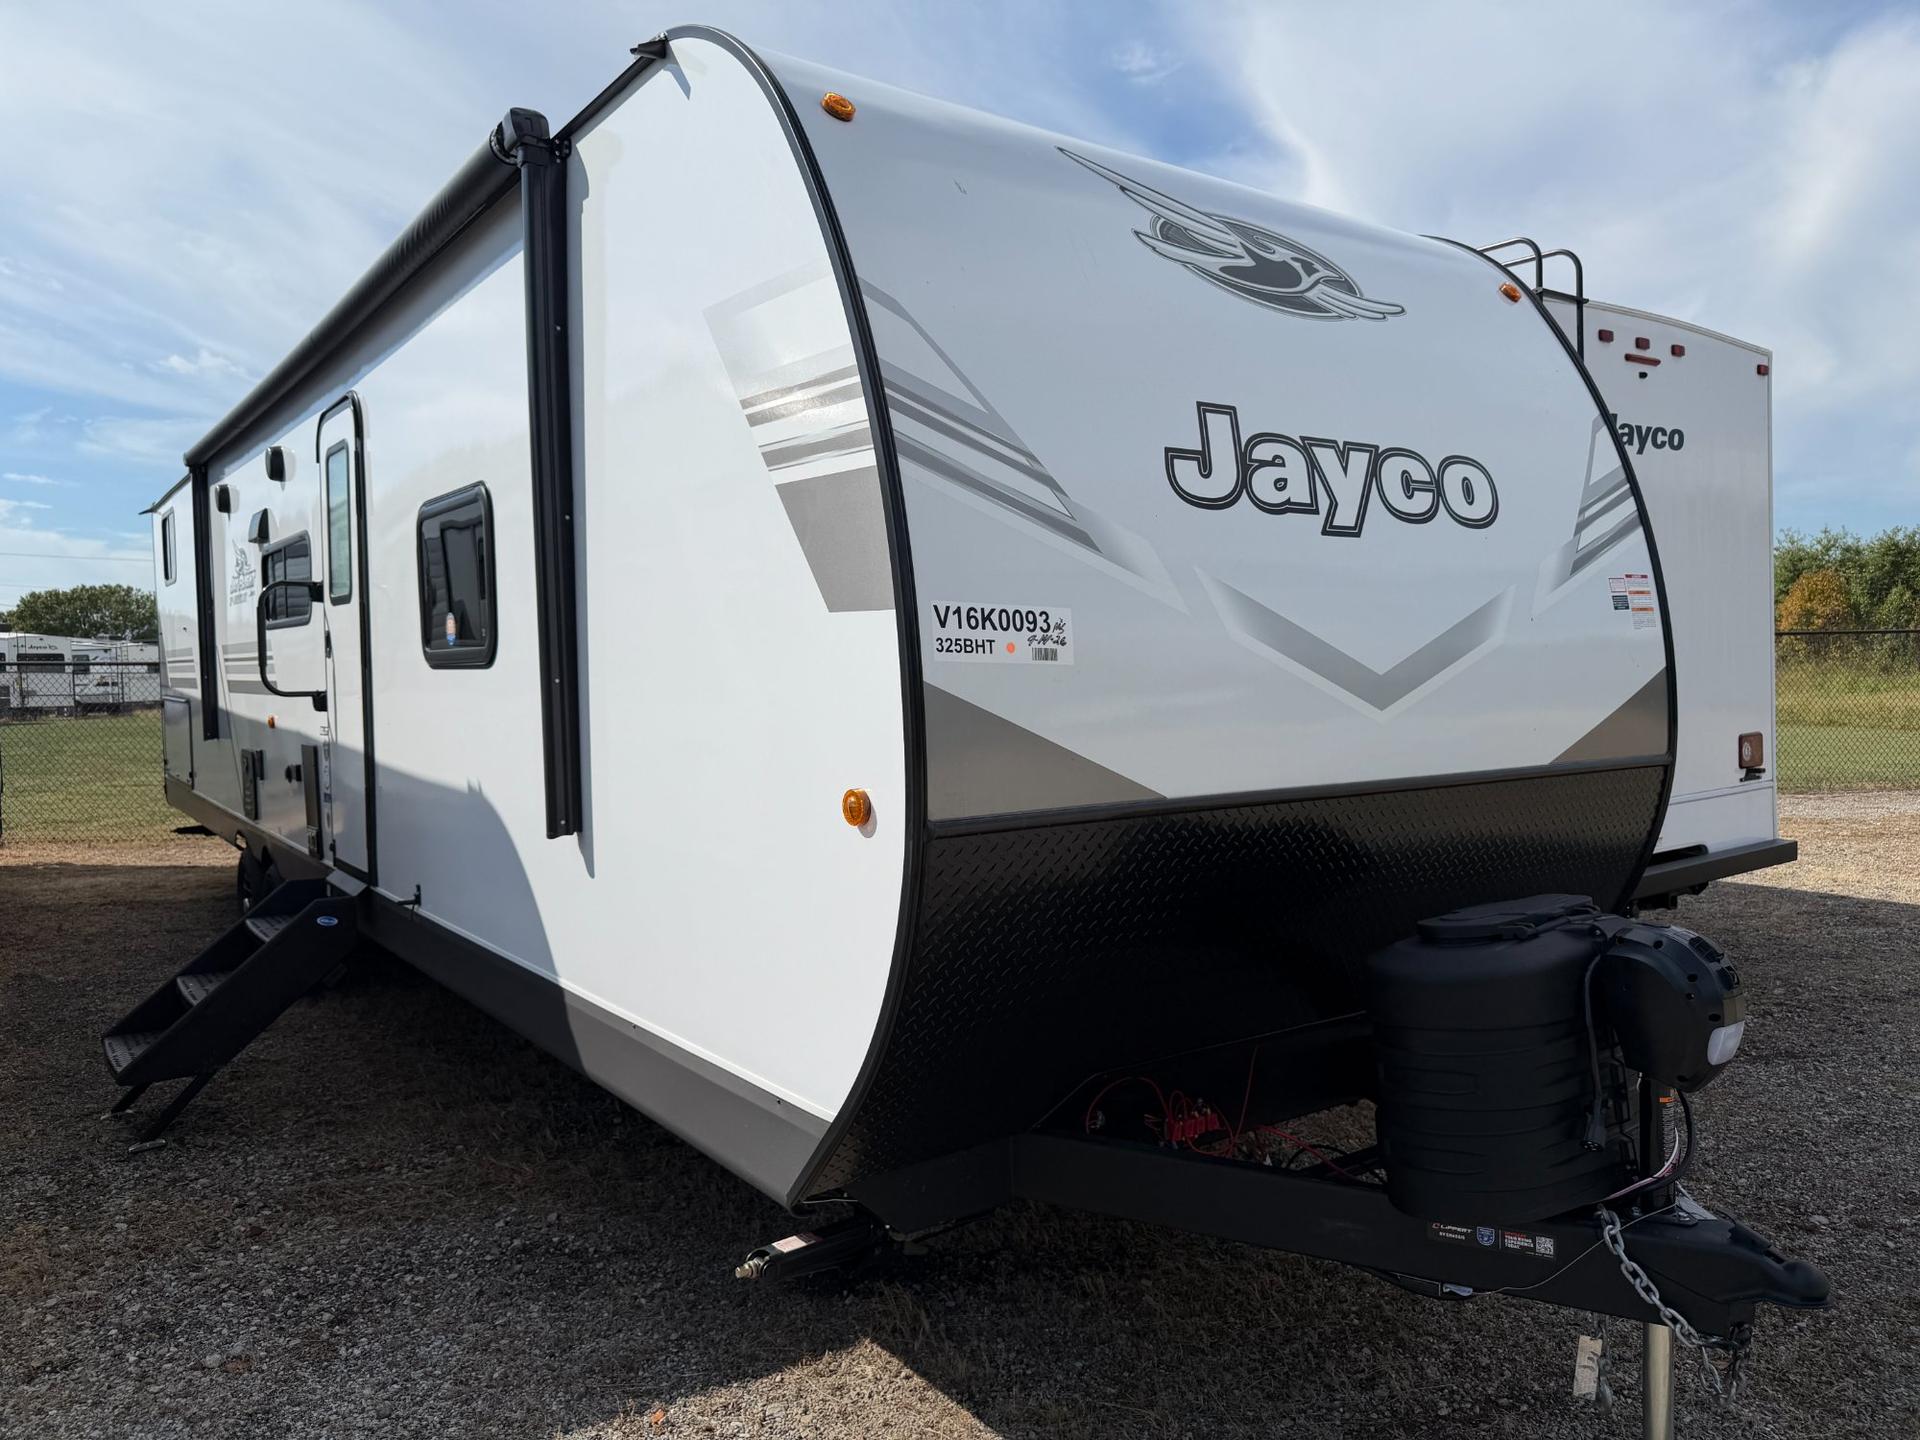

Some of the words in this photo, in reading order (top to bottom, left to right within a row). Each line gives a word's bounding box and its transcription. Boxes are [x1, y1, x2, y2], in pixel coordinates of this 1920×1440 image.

[1164, 400, 1500, 538] Jayco
[932, 604, 1051, 634] V16K0093
[935, 637, 996, 655] 325BHT
